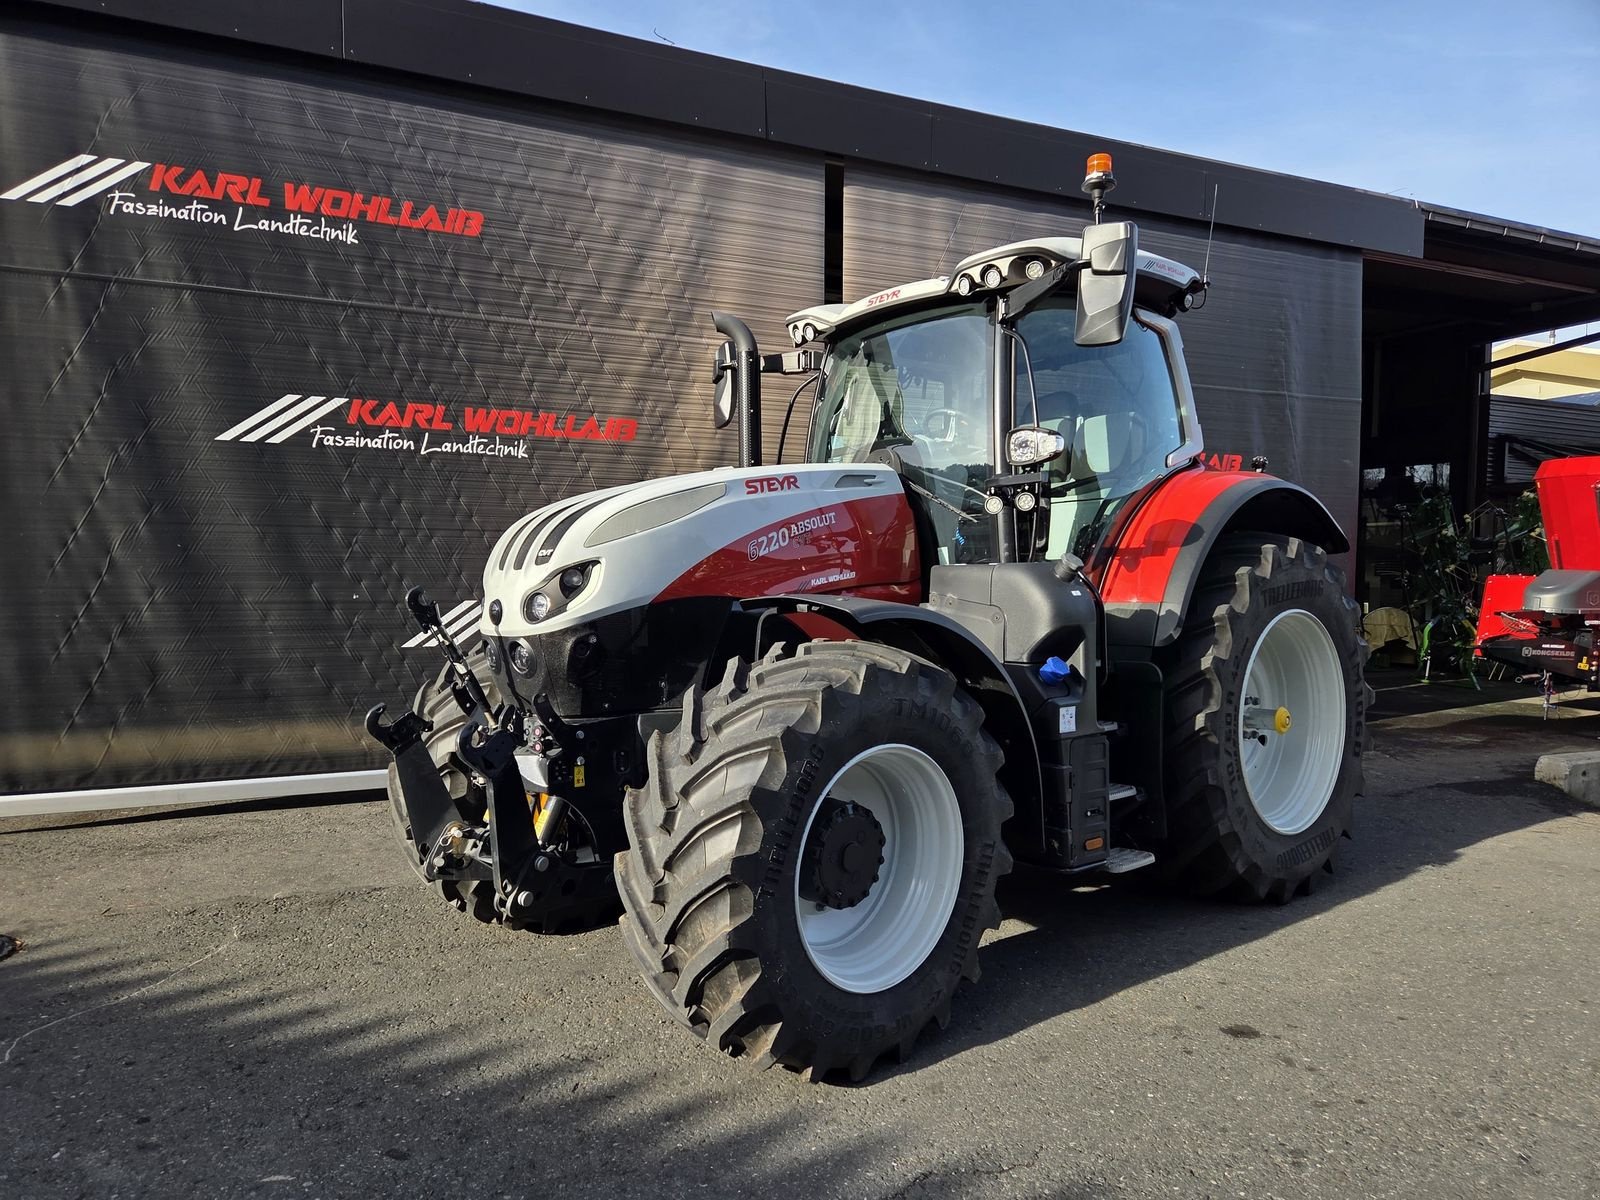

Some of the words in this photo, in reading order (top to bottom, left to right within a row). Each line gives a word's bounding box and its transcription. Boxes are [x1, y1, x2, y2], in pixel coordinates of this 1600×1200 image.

[107, 189, 227, 225] Faszination
[233, 206, 359, 245] Landtechnik
[149, 163, 271, 207] KARL
[284, 182, 485, 237] WOHLLAIB
[866, 289, 901, 308] STEYR
[347, 398, 453, 431] KARL
[464, 406, 639, 442] WOHLLAIB
[310, 424, 415, 451] Faszination
[420, 431, 529, 459] Landtechnik
[744, 474, 800, 495] STEYR
[747, 527, 789, 562] 6220
[790, 512, 836, 537] ABSOLUT
[811, 576, 829, 586] KARL
